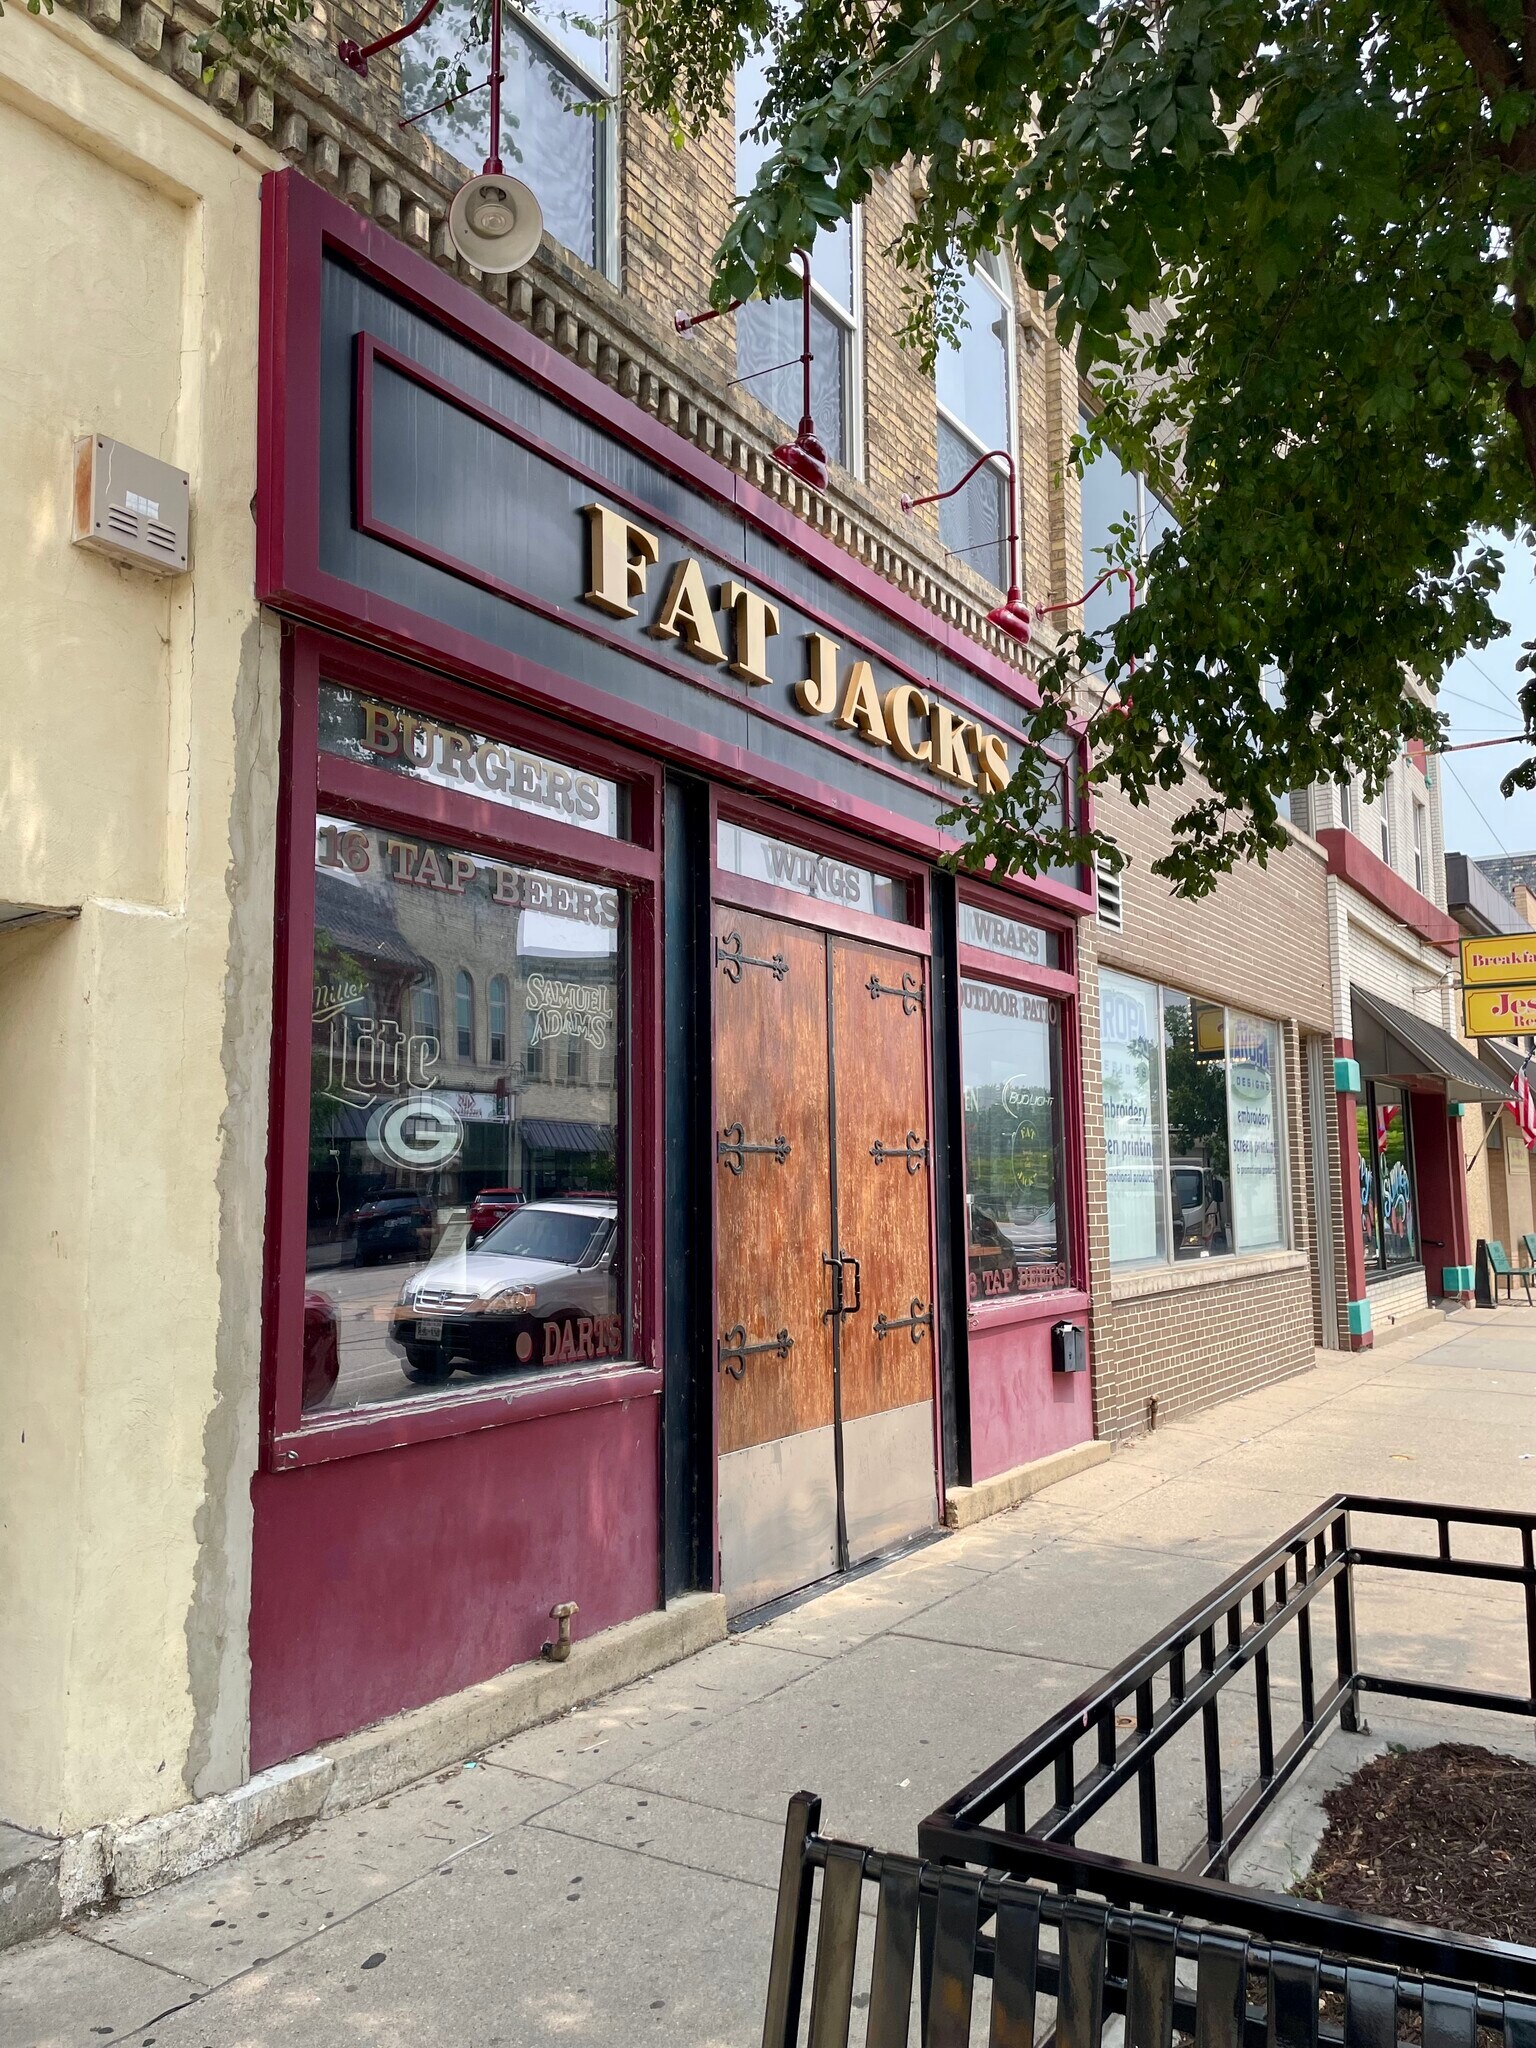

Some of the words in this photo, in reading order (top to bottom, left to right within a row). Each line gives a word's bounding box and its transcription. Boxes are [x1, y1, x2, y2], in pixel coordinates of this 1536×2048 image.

[583, 503, 780, 686] FAT
[795, 631, 1011, 795] JACK'S
[360, 701, 600, 820] BURGERS
[319, 825, 369, 872] 16
[387, 839, 476, 894] TAP
[492, 865, 619, 929] BEERS
[766, 842, 861, 902] WINGS
[973, 911, 1039, 956] WRAPS
[526, 973, 613, 1019] SAMUEL
[1023, 996, 1057, 1025] PATIO
[1492, 994, 1536, 1015] Jes
[530, 1009, 606, 1049] ADAMS
[321, 1014, 440, 1109] Lite
[1009, 1092, 1029, 1105] BUD
[1237, 1106, 1270, 1130] embroidery
[382, 1099, 460, 1166] G
[983, 1268, 1013, 1296] TAP
[1018, 1262, 1066, 1290] BEERS
[543, 1312, 622, 1366] DARTS
